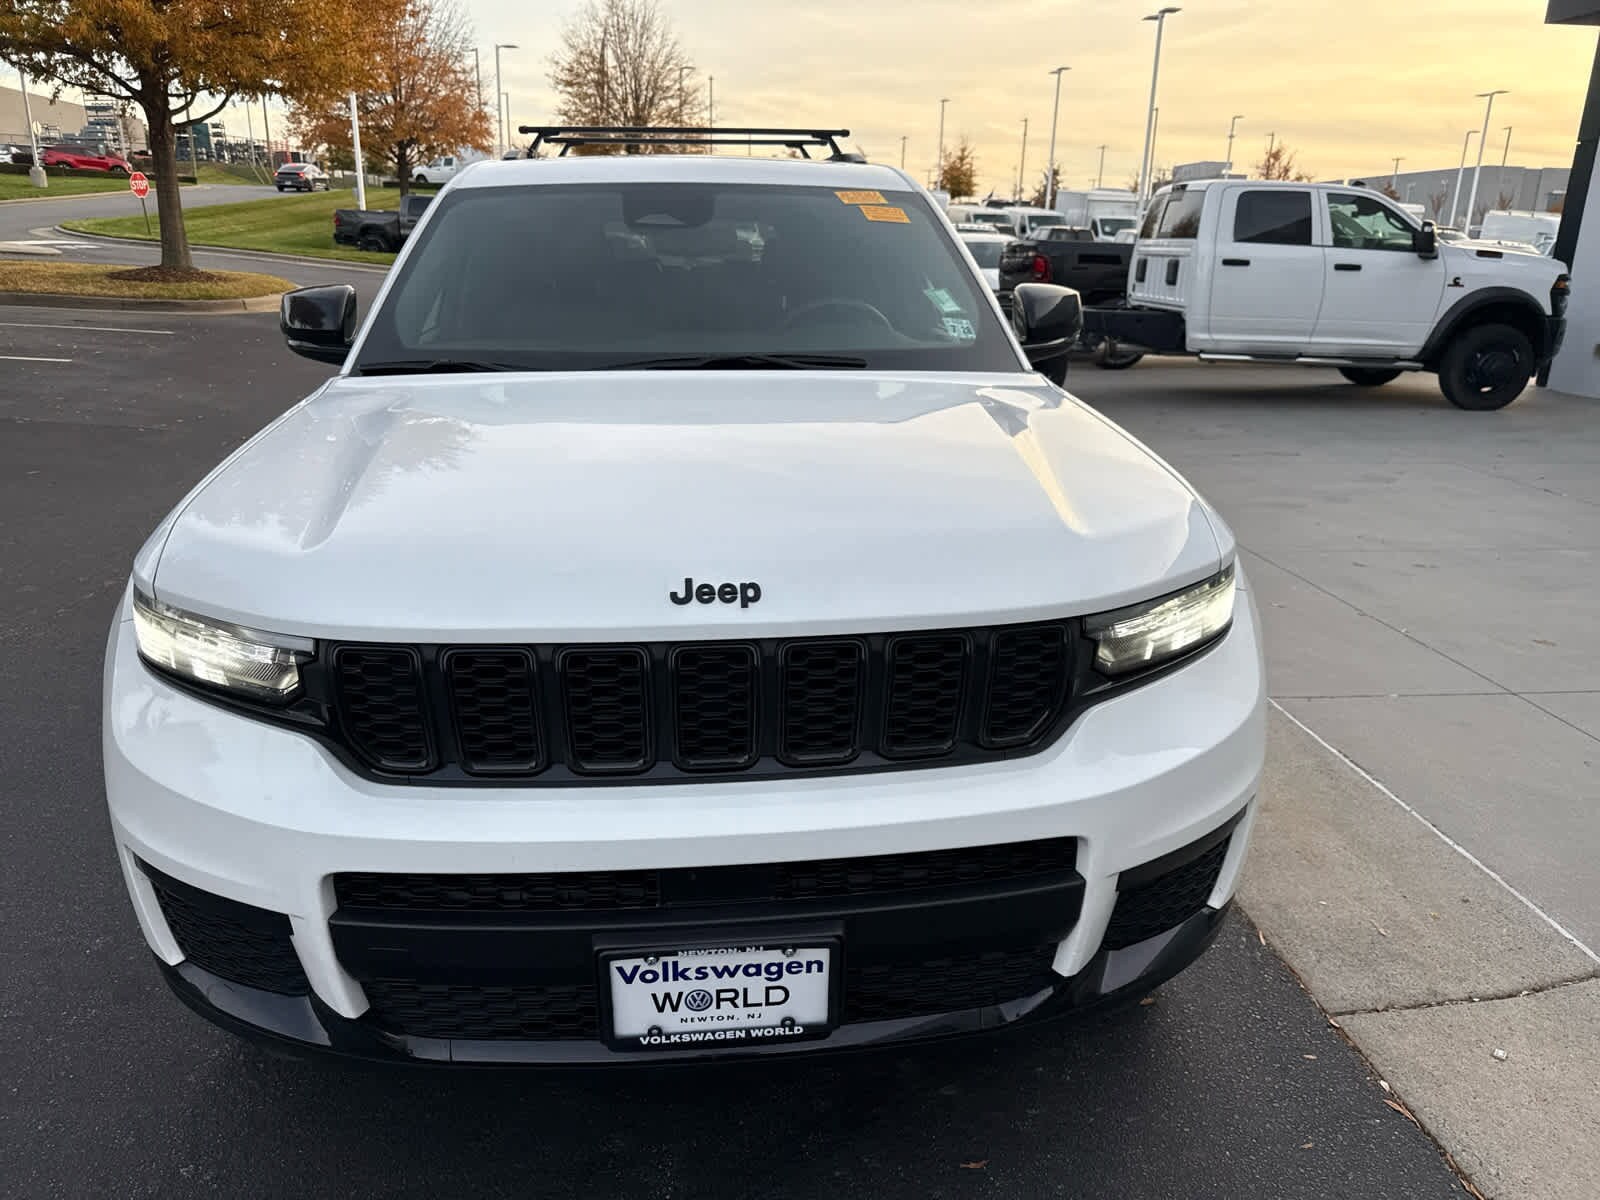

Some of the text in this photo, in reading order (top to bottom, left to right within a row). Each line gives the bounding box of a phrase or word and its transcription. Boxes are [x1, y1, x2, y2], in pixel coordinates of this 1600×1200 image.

[131, 180, 148, 190] STOP
[669, 577, 762, 609] Jeep
[615, 960, 824, 985] Volkswagen
[747, 1012, 762, 1020] NJ
[640, 1025, 804, 1046] VOLKSWAGEN WORLD
